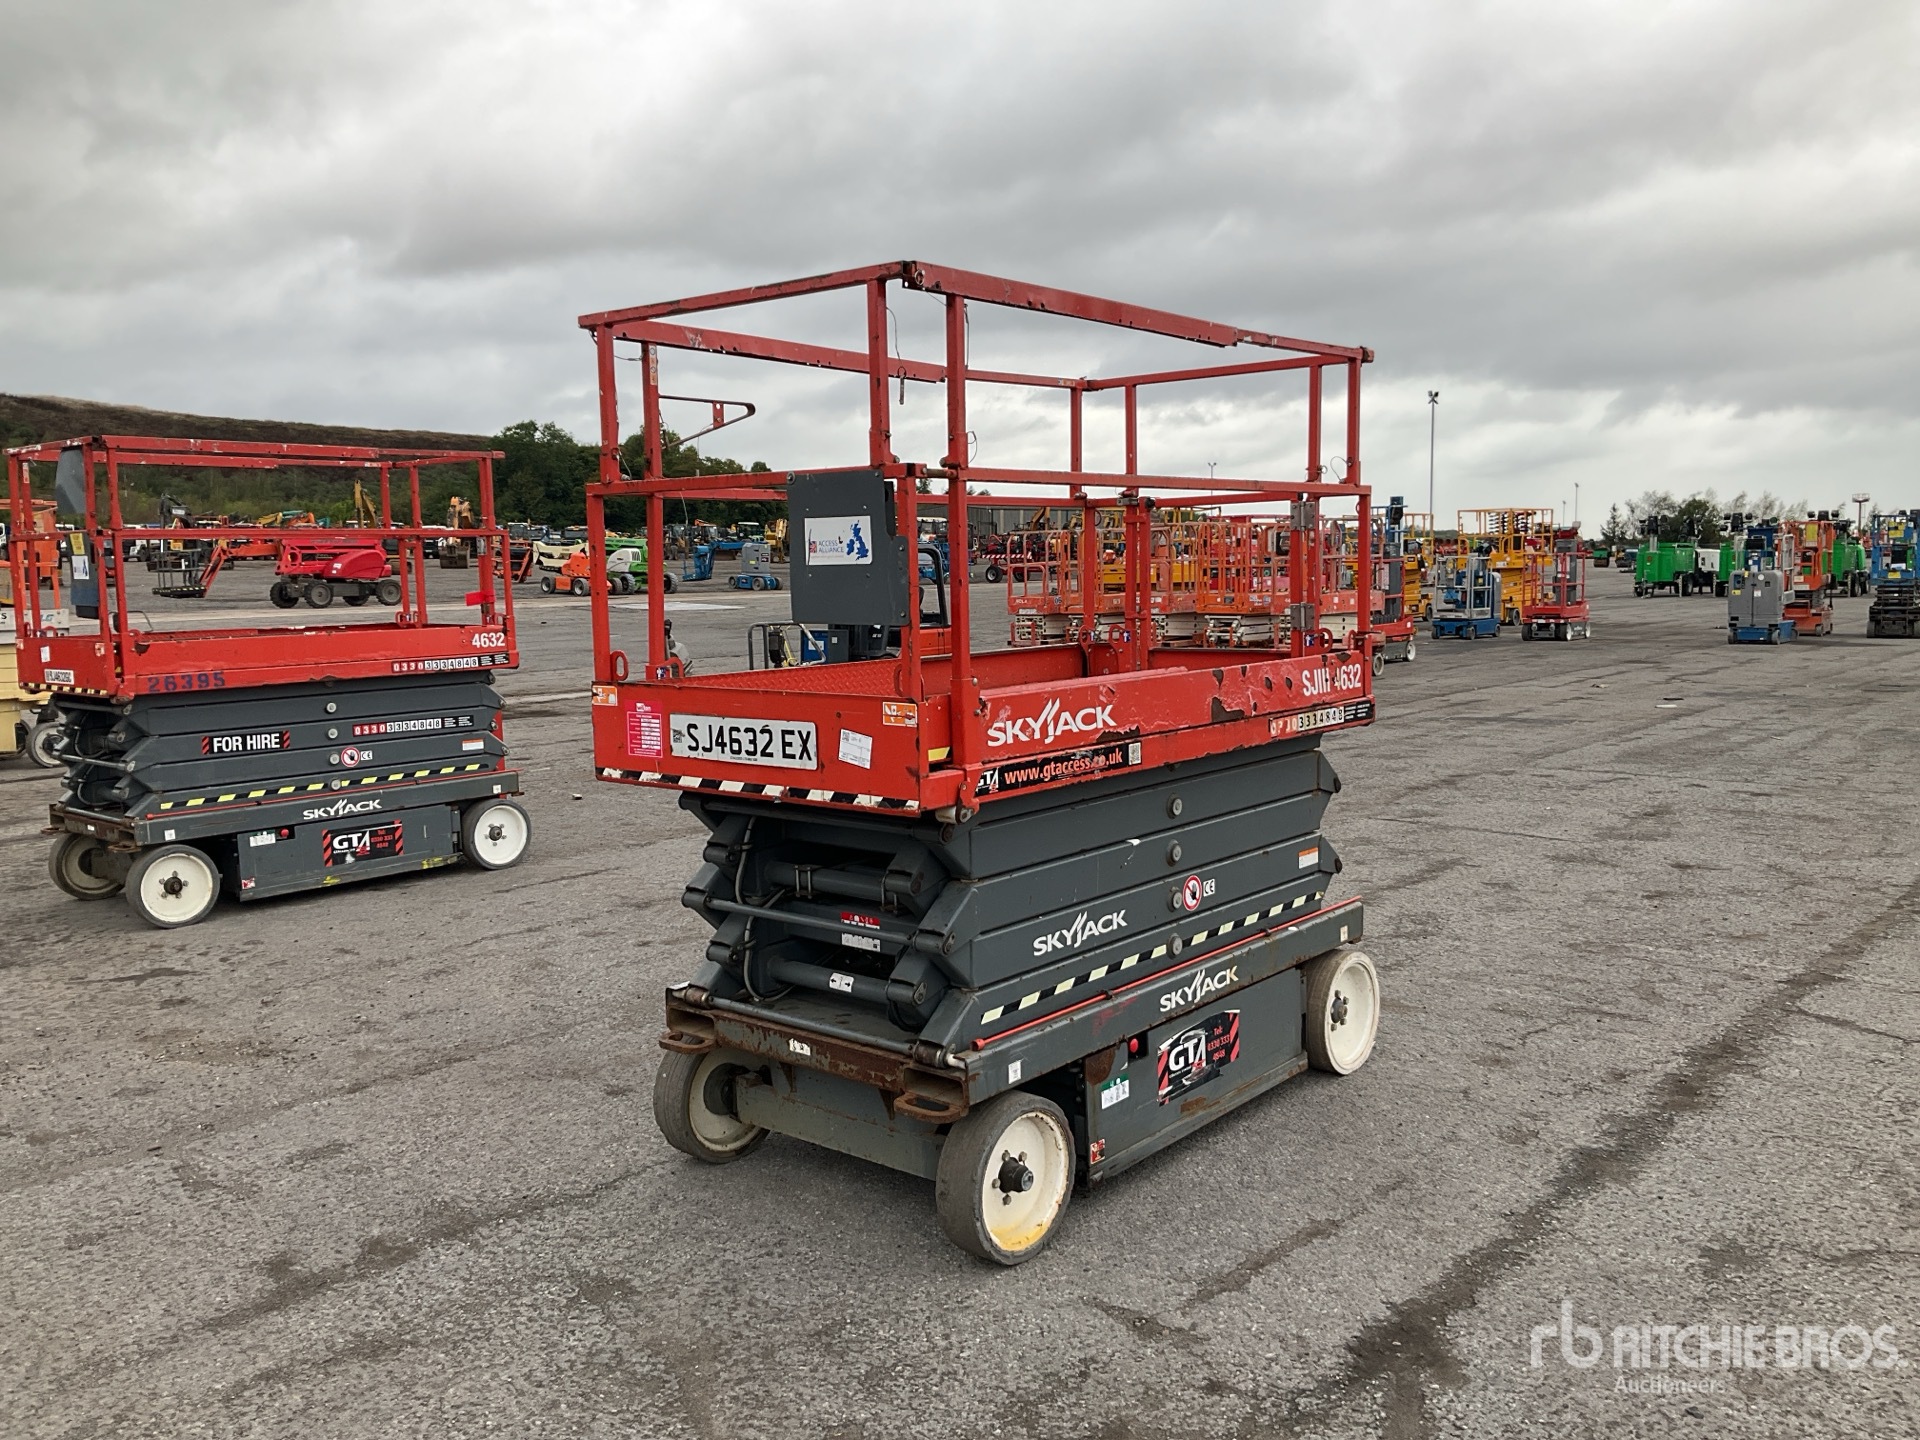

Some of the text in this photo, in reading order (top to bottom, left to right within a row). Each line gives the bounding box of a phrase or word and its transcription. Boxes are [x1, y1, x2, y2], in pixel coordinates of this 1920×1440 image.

[471, 632, 506, 648] 4632
[147, 671, 226, 694] 26395
[1333, 663, 1362, 691] 4632
[986, 697, 1117, 747] SKYJACK
[213, 733, 281, 753] FOR HIRE
[686, 723, 775, 759] SJ4632
[781, 729, 813, 762] EX
[1004, 747, 1123, 785] www.gtaccess.co.uk
[302, 798, 383, 820] SKYJACK
[1032, 909, 1128, 956] SKYJACK
[1159, 965, 1239, 1012] SKYJACK
